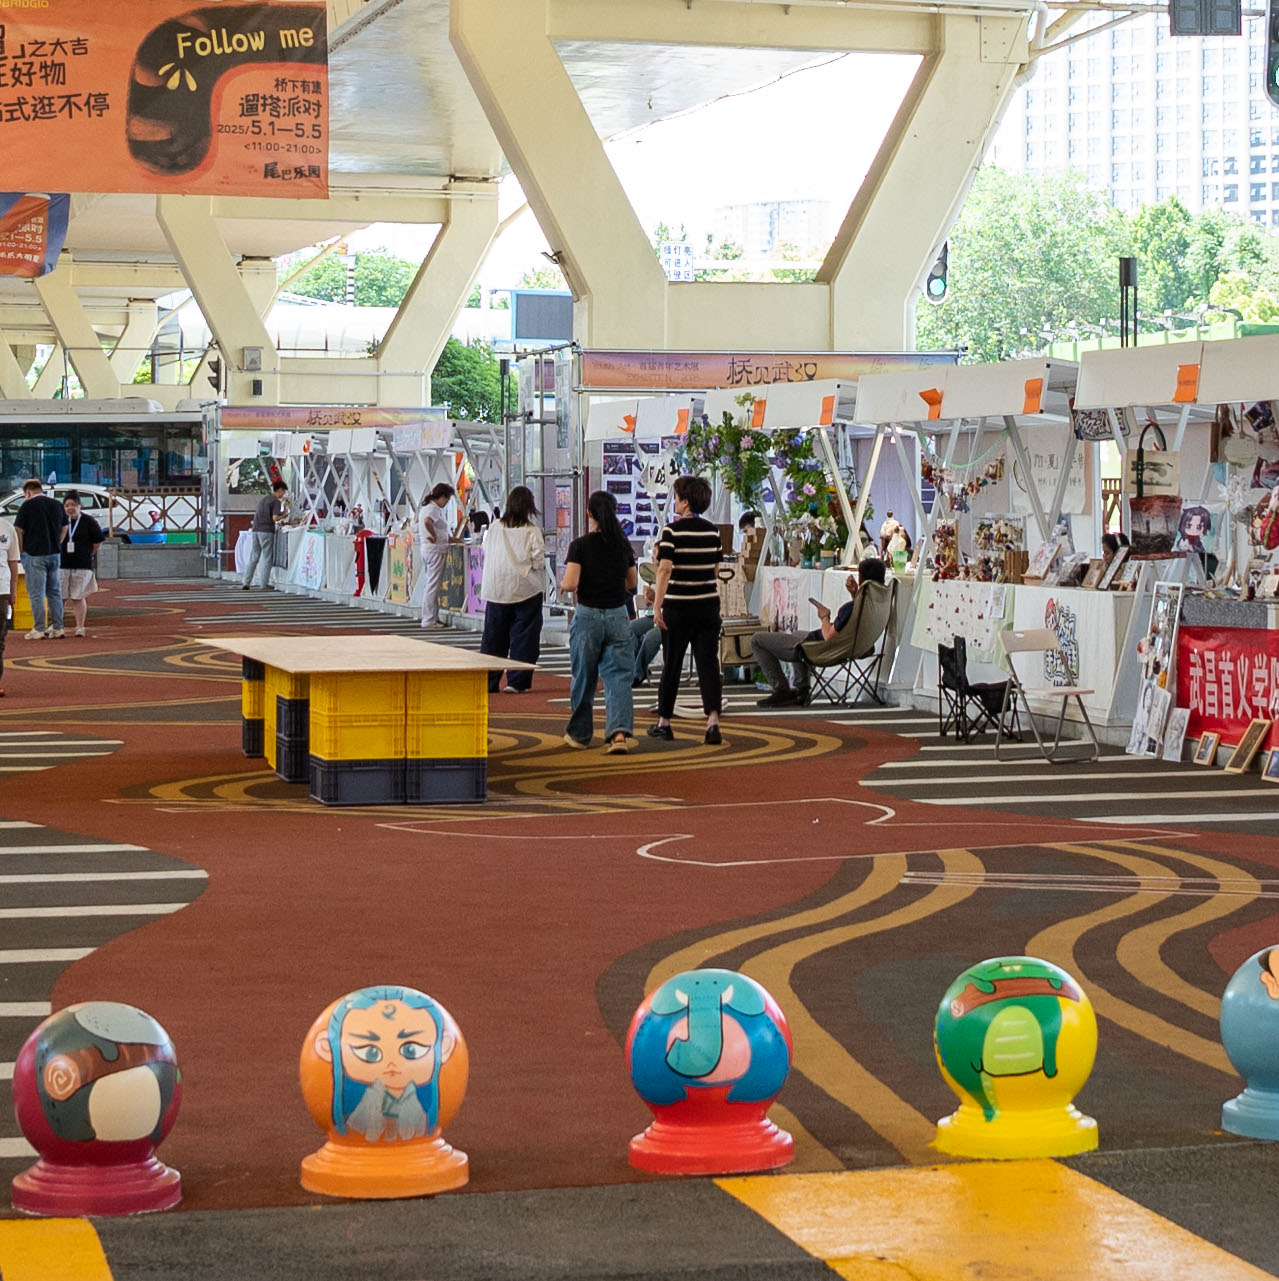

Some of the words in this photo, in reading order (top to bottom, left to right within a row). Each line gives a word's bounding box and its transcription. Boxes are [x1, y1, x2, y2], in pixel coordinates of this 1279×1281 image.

[176, 29, 265, 59] Follow
[279, 26, 314, 49] me
[273, 77, 322, 95] 桥下有集
[0, 93, 110, 122] 式逛不停
[238, 94, 322, 120] 遛搭派对
[243, 141, 322, 155] <11:00-21:00>
